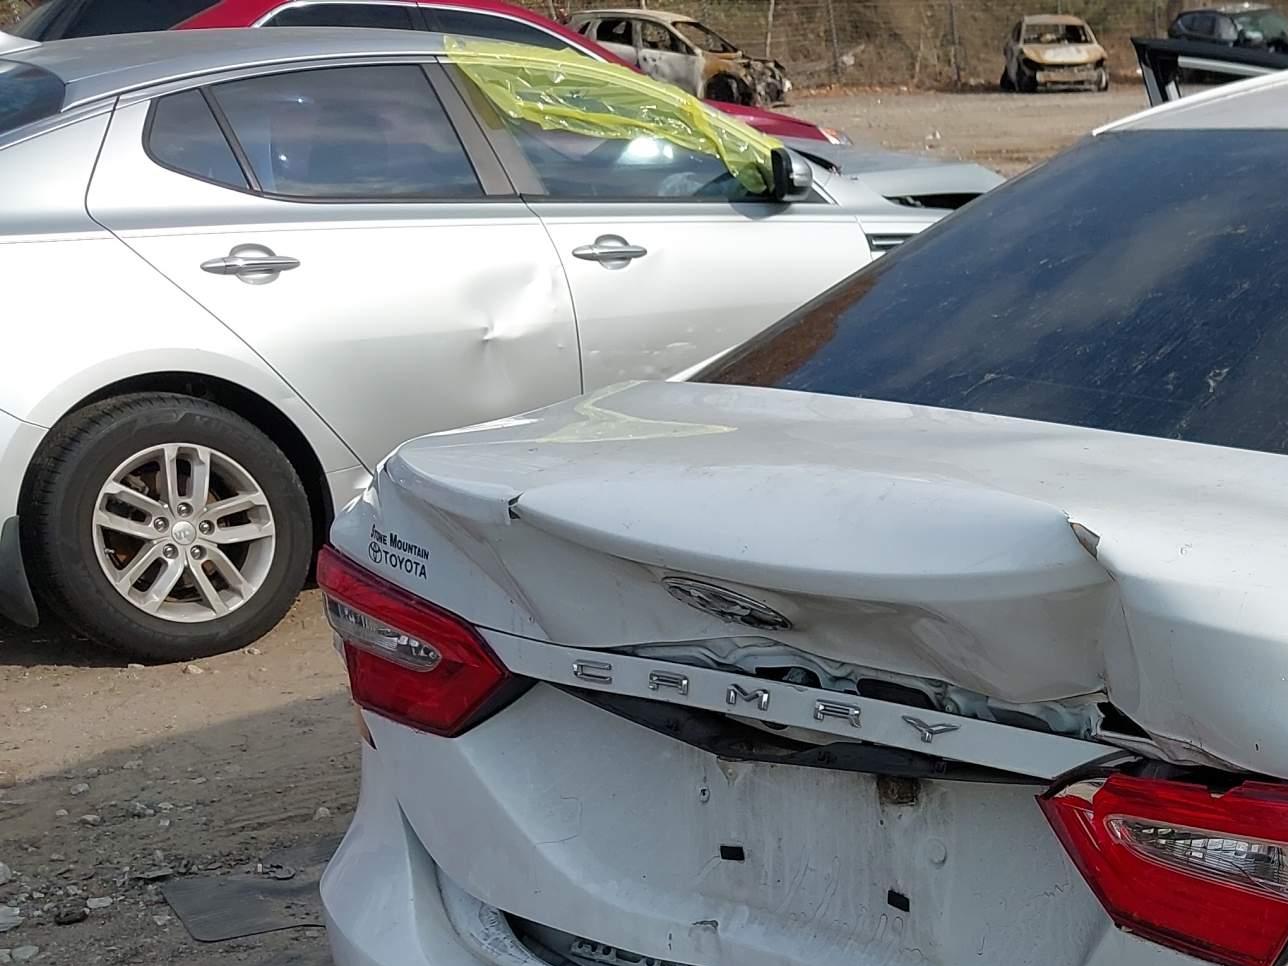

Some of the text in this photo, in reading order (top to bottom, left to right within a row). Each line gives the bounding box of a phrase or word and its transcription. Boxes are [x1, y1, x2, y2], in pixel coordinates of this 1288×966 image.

[390, 533, 429, 560] MOUNTAIN
[382, 550, 427, 579] TOYOTA
[571, 658, 960, 743] CAMRY
